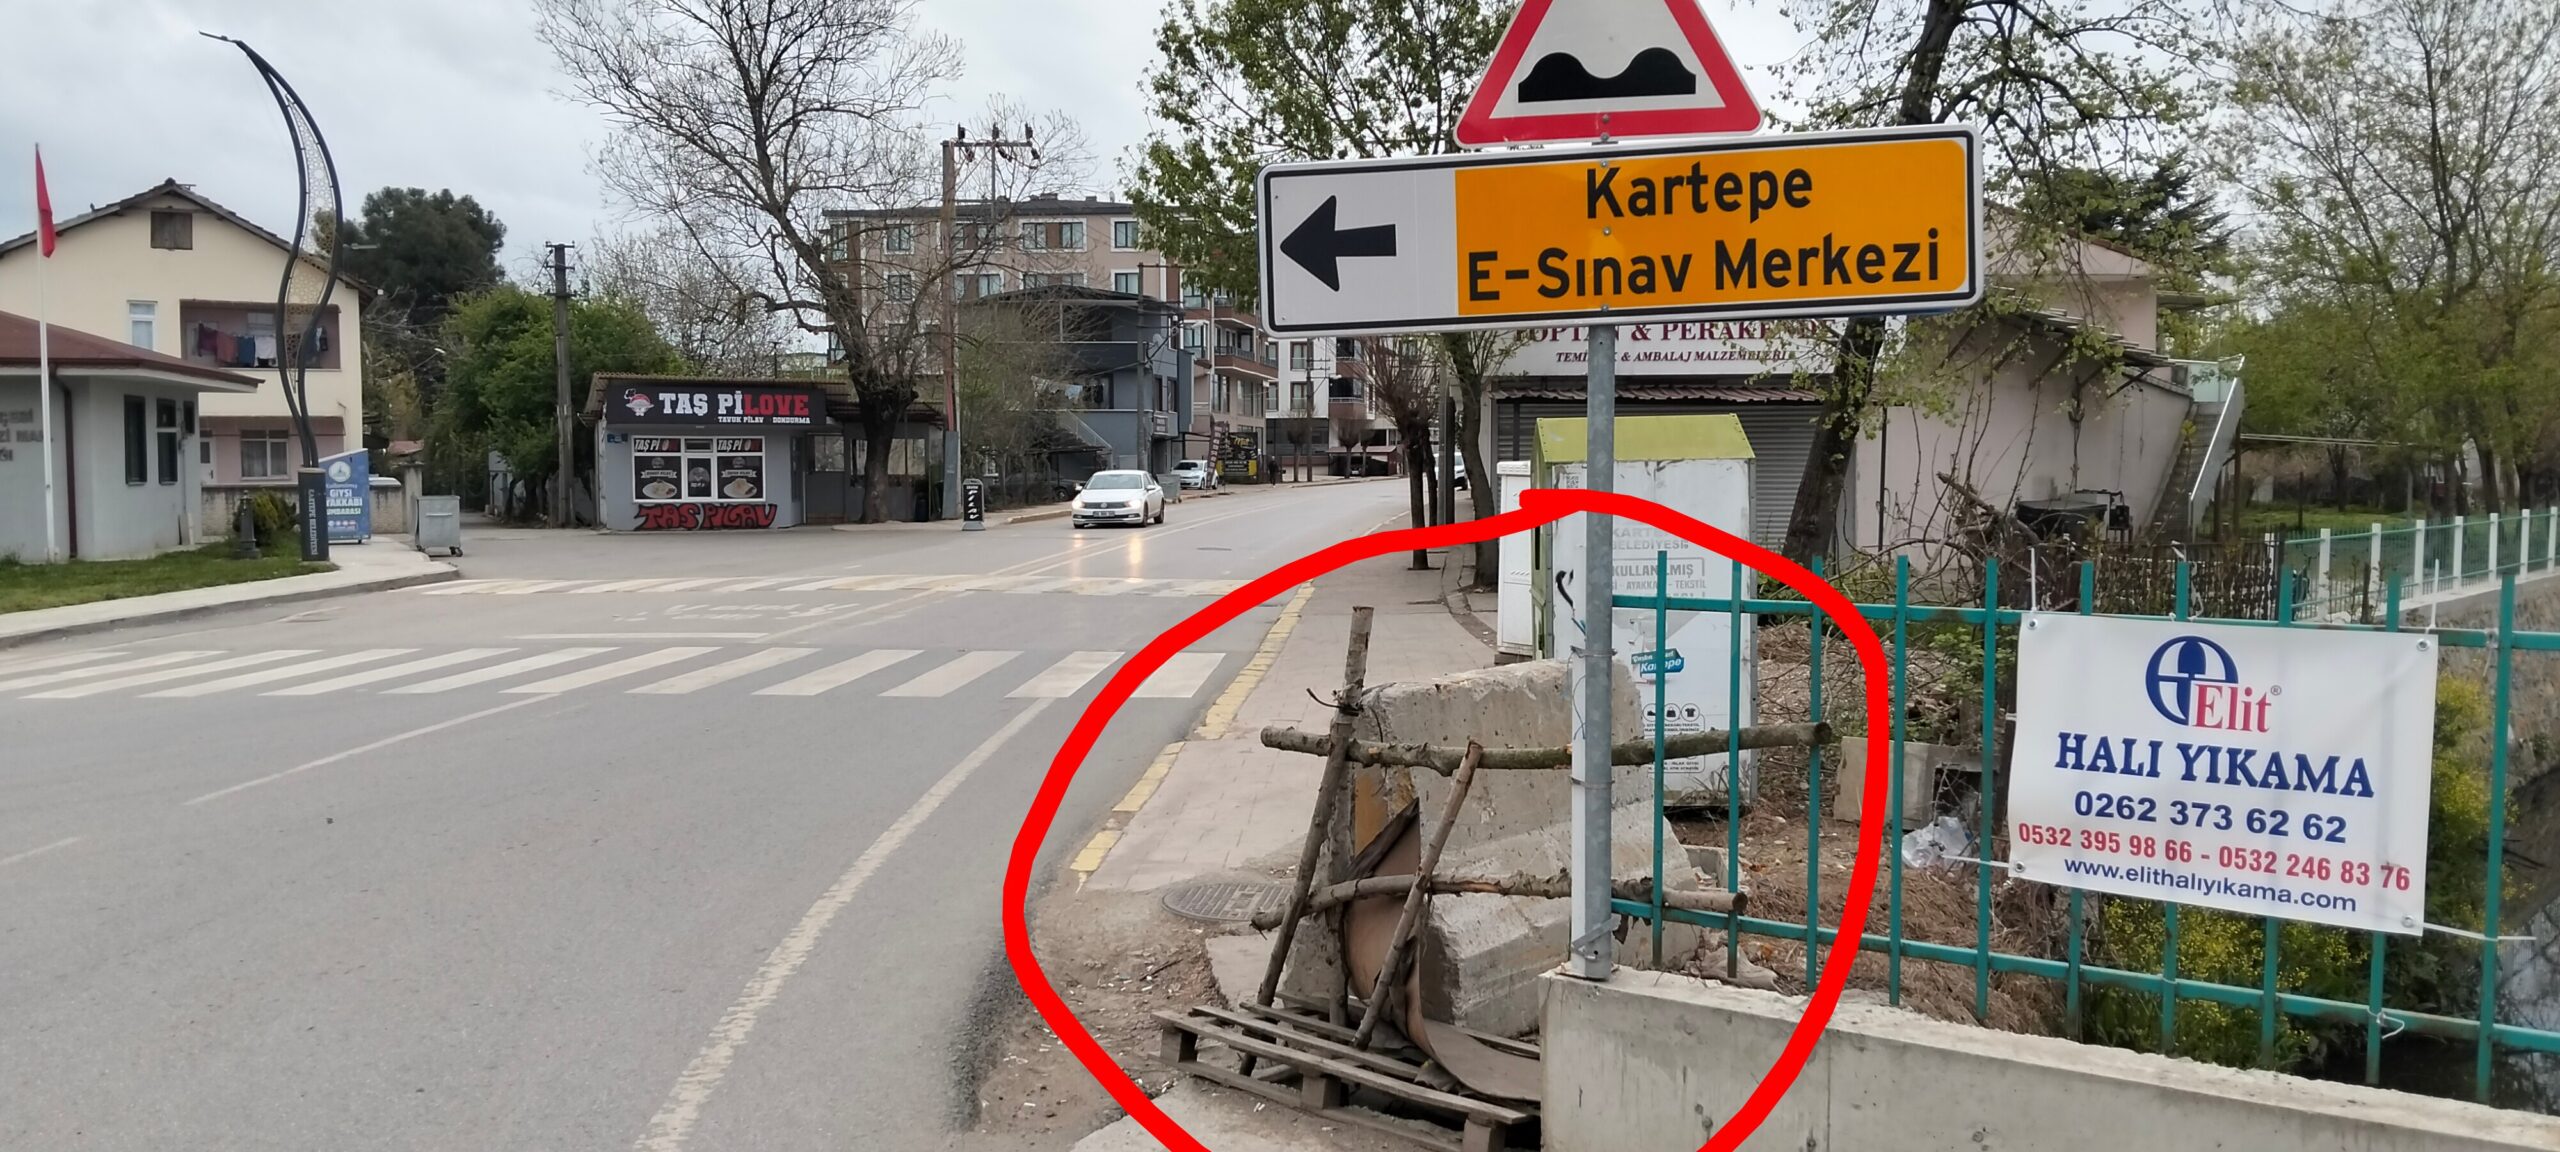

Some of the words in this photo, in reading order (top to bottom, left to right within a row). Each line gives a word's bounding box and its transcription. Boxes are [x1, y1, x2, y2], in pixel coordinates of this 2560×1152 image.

[1586, 161, 1813, 223] Kartepe
[1468, 247, 1693, 302] E-Sınav
[1715, 228, 1939, 291] Merkezi
[1621, 351, 1631, 362] &
[1633, 351, 1691, 362] AMBALAJ
[1631, 323, 1651, 342] &
[659, 393, 708, 416] TAŞ
[718, 391, 809, 416] PİLOVE
[718, 416, 742, 424] TAVUK
[773, 416, 811, 424] DONDURMA
[2192, 683, 2272, 733] Elit
[2054, 731, 2163, 778] HALI
[2176, 742, 2375, 798] YIKAMA
[2074, 790, 2157, 823] 0262
[2169, 800, 2233, 831] 373
[2245, 808, 2289, 836] 62
[2302, 813, 2347, 843] 62
[2018, 822, 2072, 847] 0532
[2080, 829, 2121, 853] 395
[2129, 834, 2156, 858] 98
[2164, 838, 2192, 863] 66
[2219, 845, 2278, 874] 0532
[2286, 853, 2331, 881] 246
[2340, 860, 2370, 886] 83
[2380, 863, 2410, 891] 76
